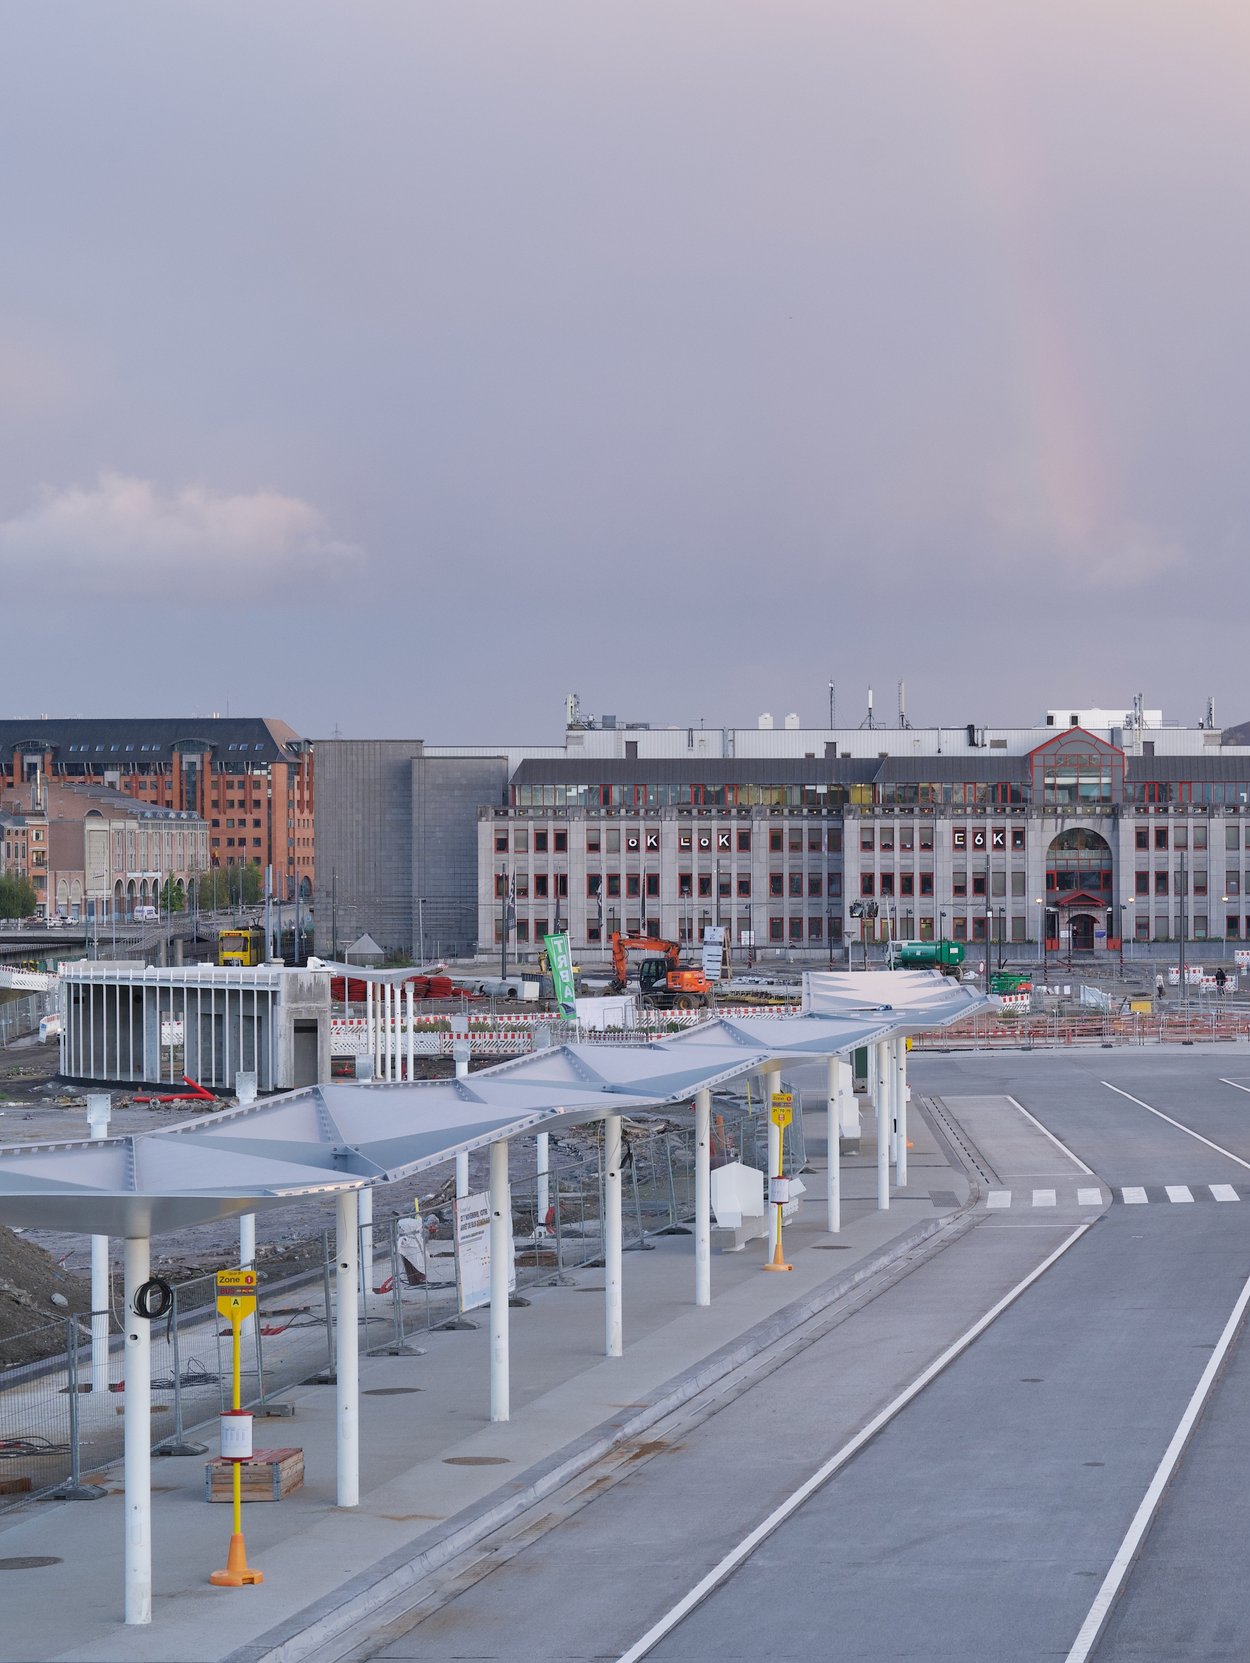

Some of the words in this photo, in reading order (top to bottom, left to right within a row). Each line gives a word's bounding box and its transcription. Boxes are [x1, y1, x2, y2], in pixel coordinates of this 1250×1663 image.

[954, 833, 1004, 845] E6K
[553, 939, 573, 999] TRBA
[219, 1275, 241, 1284] Zone
[220, 1287, 236, 1295] BUS
[232, 1298, 240, 1306] A
